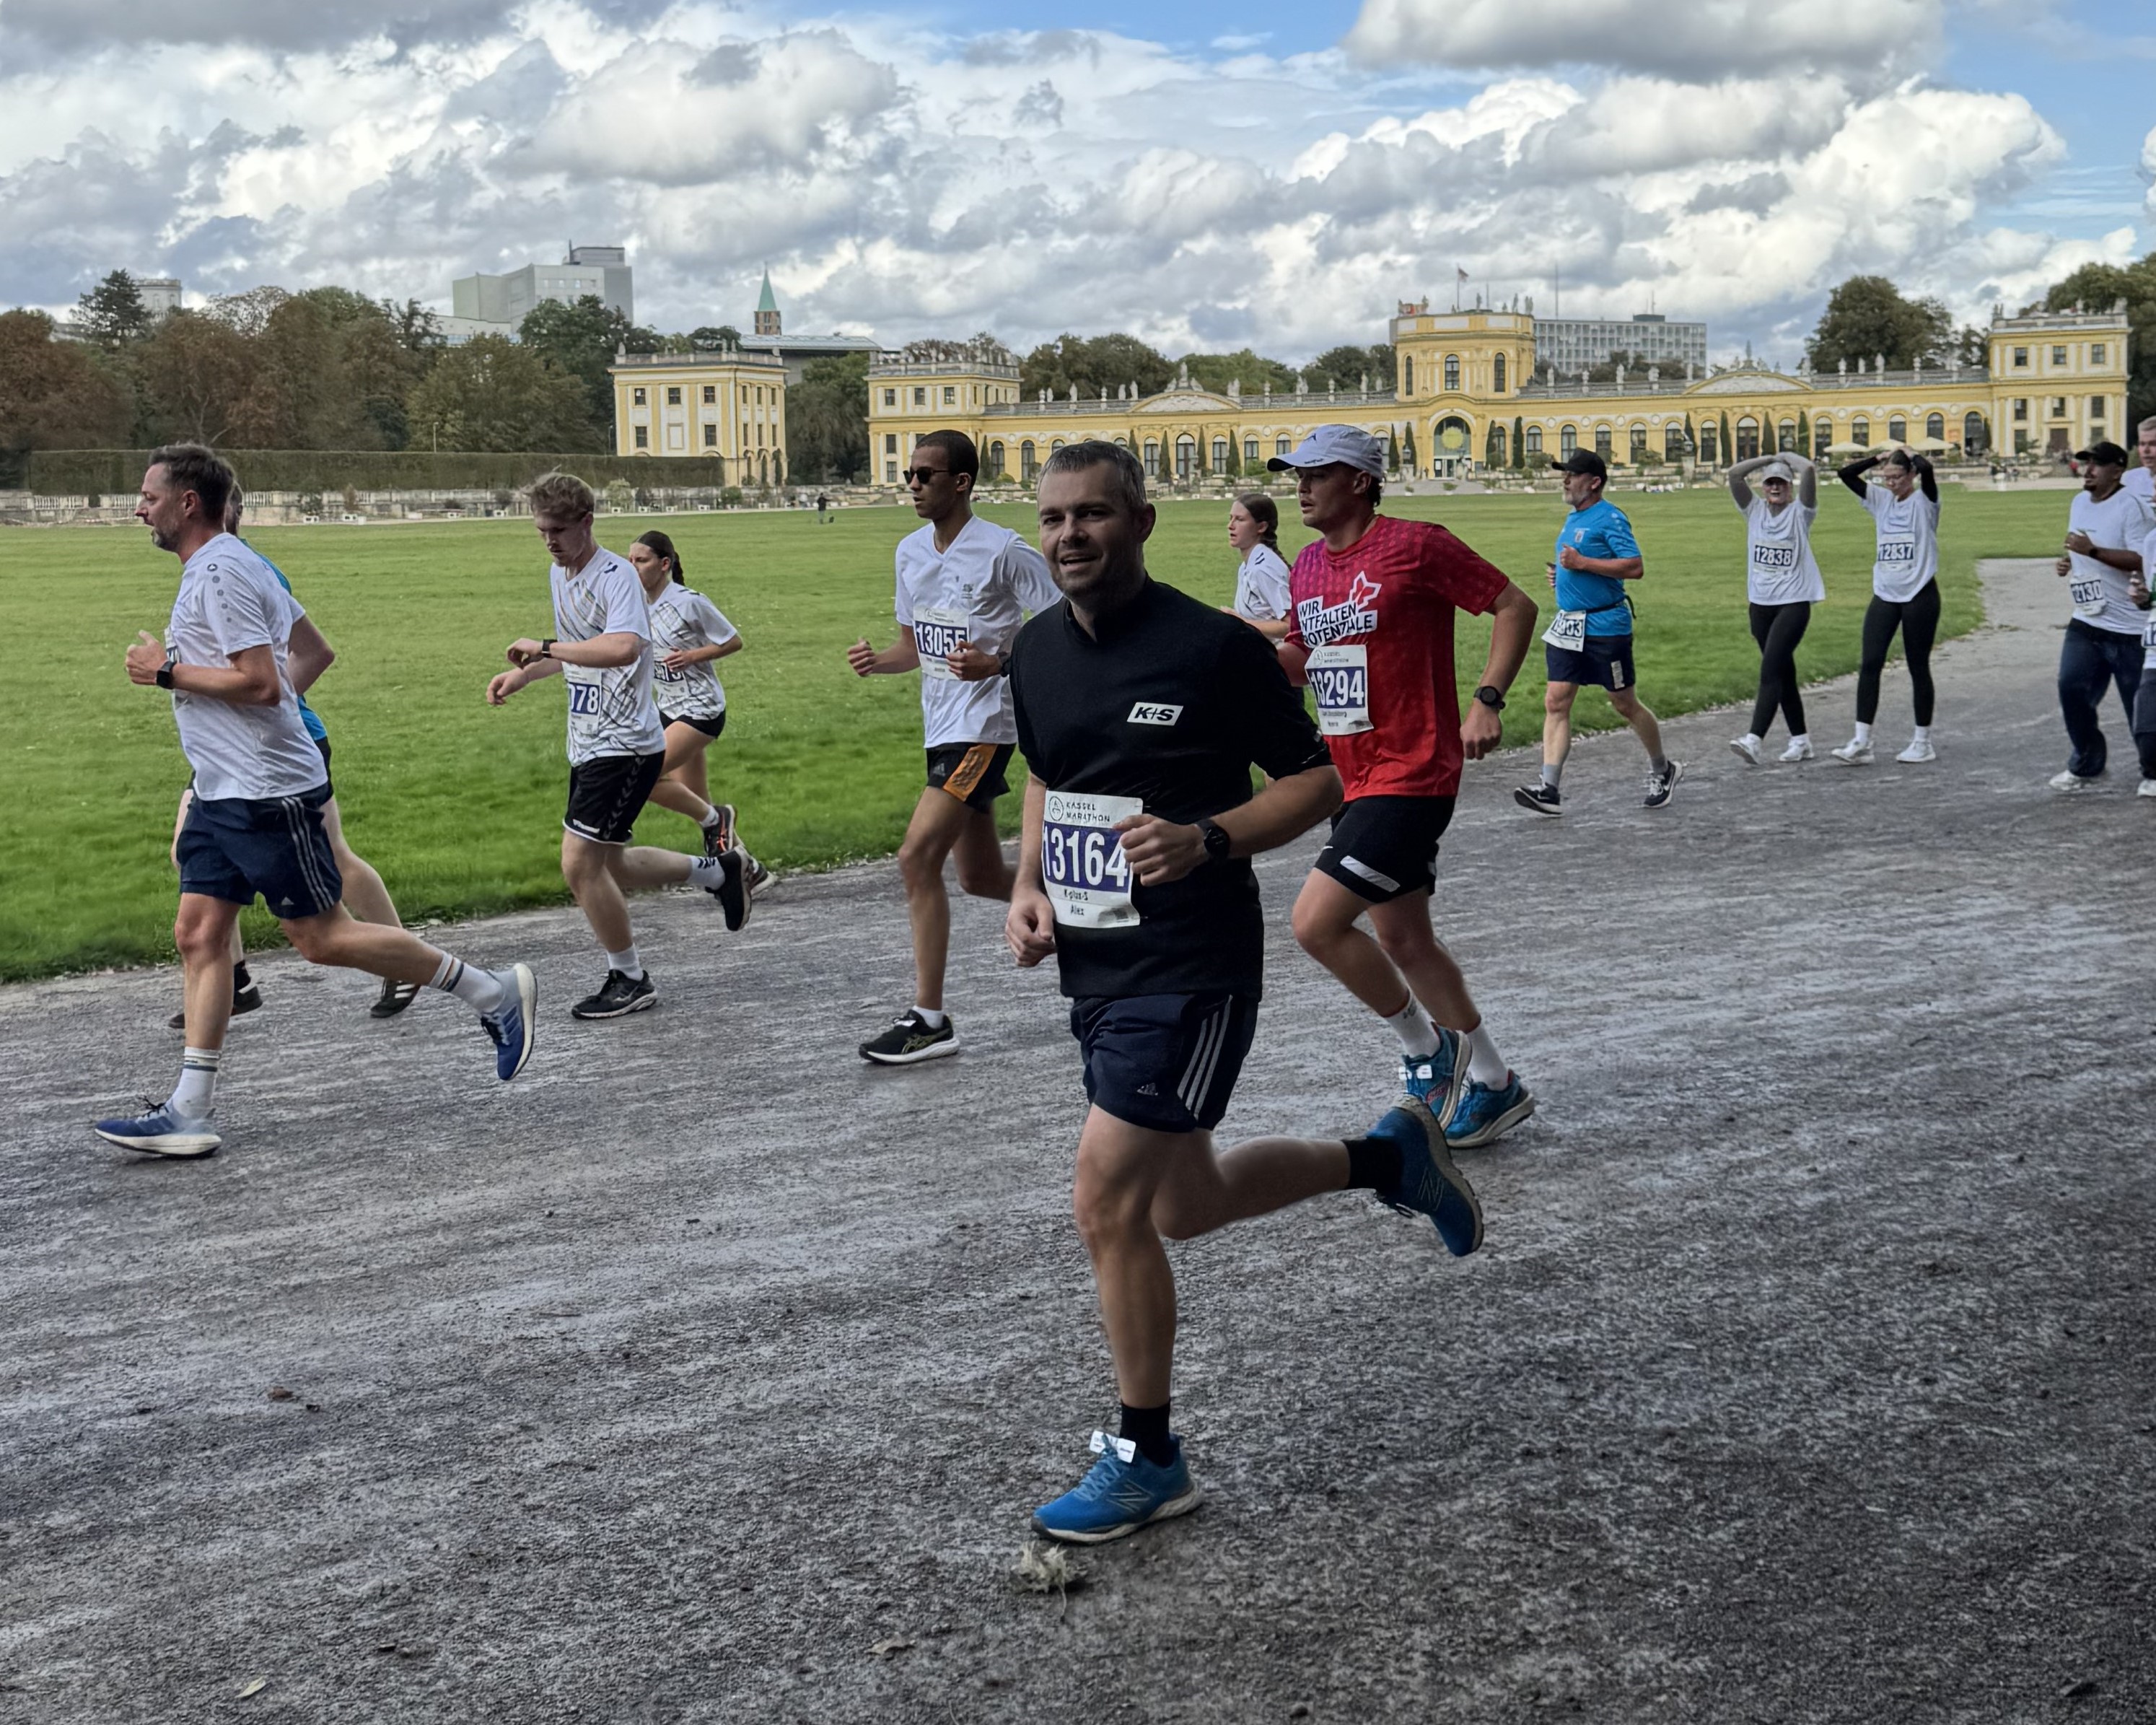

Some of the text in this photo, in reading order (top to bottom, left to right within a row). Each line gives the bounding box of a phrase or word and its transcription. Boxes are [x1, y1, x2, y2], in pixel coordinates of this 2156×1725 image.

[1755, 547, 1792, 565] 12838
[1300, 601, 1320, 618] WIR
[1302, 603, 1357, 632] NTFALTEN
[1310, 670, 1364, 706] 13294
[1134, 707, 1175, 721] K+S
[1066, 801, 1096, 811] KASSEL
[1066, 811, 1110, 822] MARATHON
[1043, 825, 1129, 888] 13164
